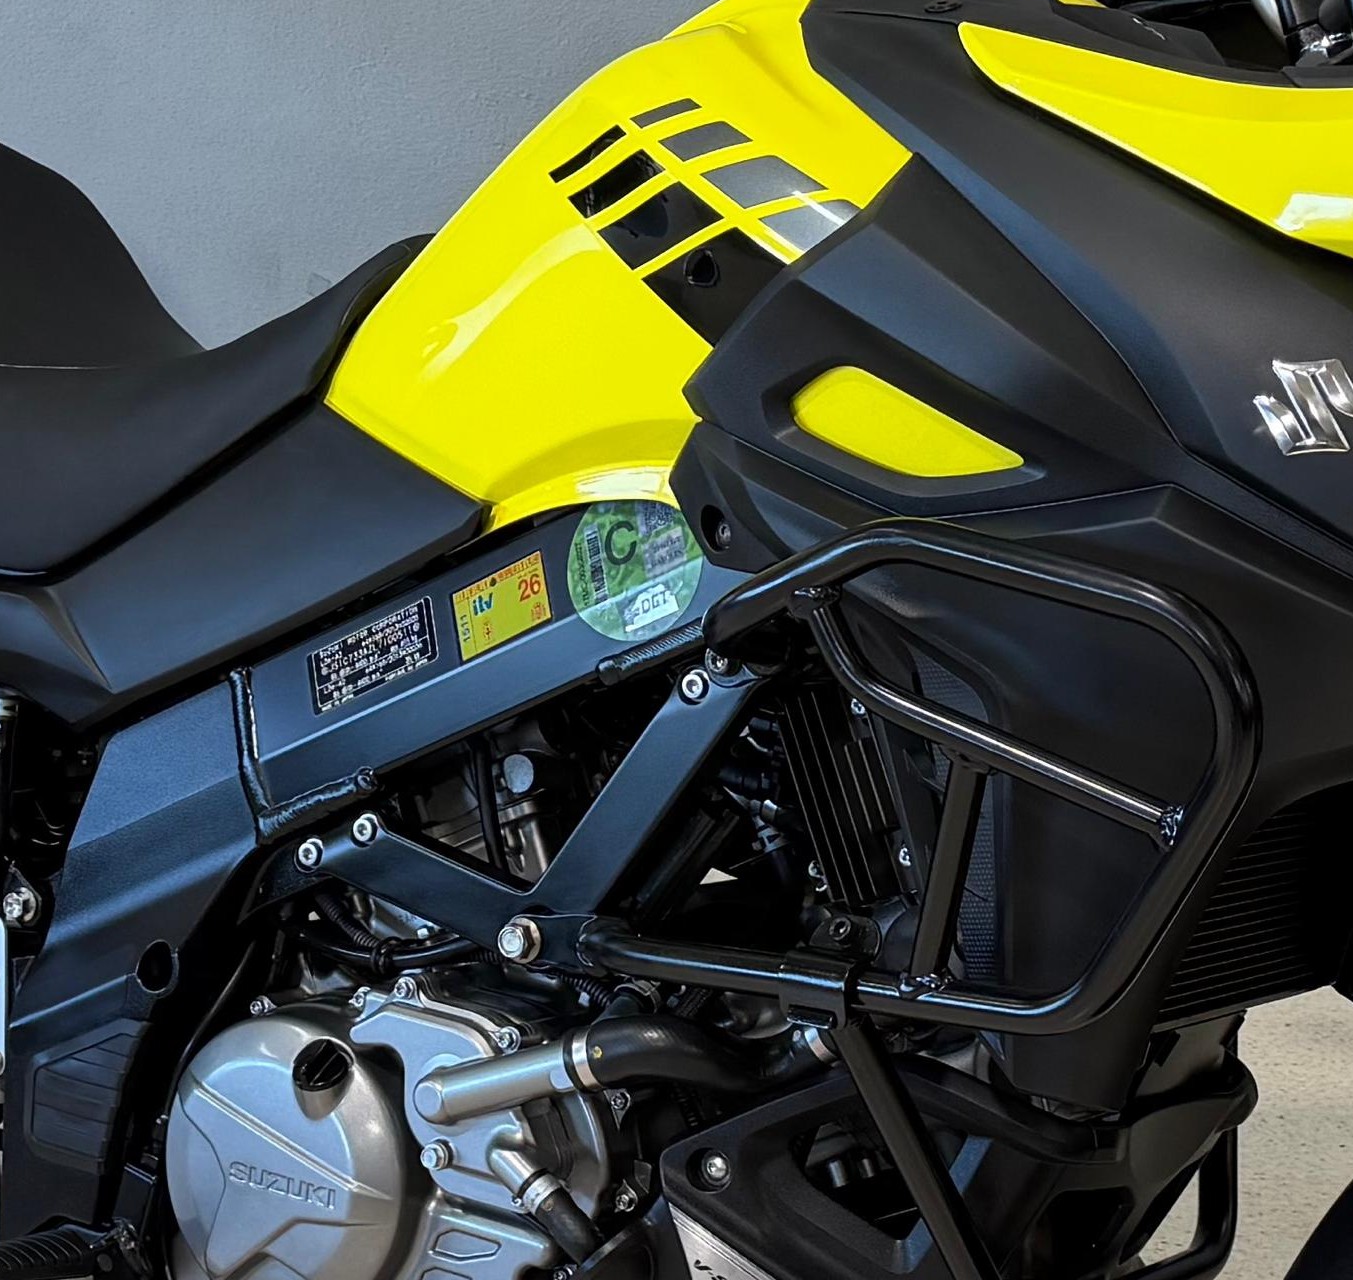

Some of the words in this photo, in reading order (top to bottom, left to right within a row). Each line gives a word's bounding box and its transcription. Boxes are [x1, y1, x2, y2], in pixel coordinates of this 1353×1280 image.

[605, 520, 637, 566] C
[518, 573, 542, 602] 26
[229, 1161, 336, 1210] SUZUKI
